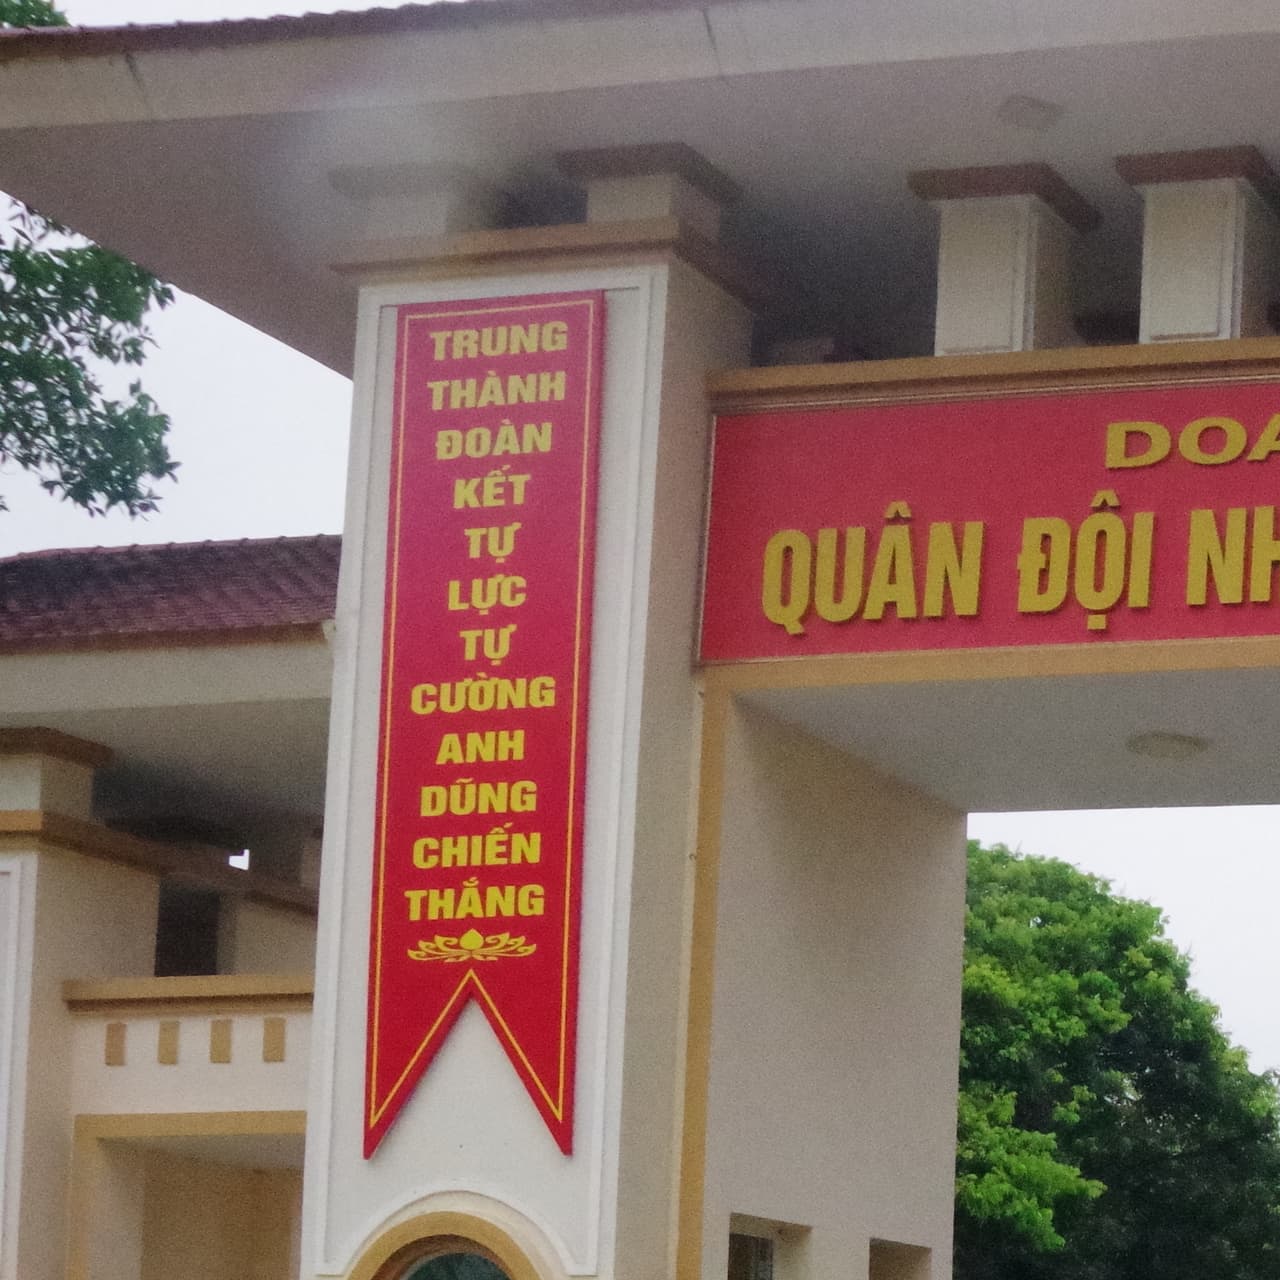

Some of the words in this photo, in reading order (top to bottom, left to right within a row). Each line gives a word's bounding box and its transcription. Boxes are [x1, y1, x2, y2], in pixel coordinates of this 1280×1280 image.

[430, 321, 567, 360] TRUNG
[427, 370, 566, 410] THÀNH
[436, 420, 552, 459] ĐOÀN
[454, 468, 530, 509] KẾT
[464, 522, 521, 559] TỰ
[762, 501, 983, 634] QUÂN
[1017, 490, 1154, 629] ĐỘI
[448, 574, 526, 614] LỰC
[460, 624, 516, 665] TỰ
[411, 674, 555, 715] CƯỜNG
[437, 730, 524, 764] ANH
[421, 779, 536, 816] DŨNG
[413, 823, 541, 868] CHIẾN
[404, 878, 544, 921] THẮNG
